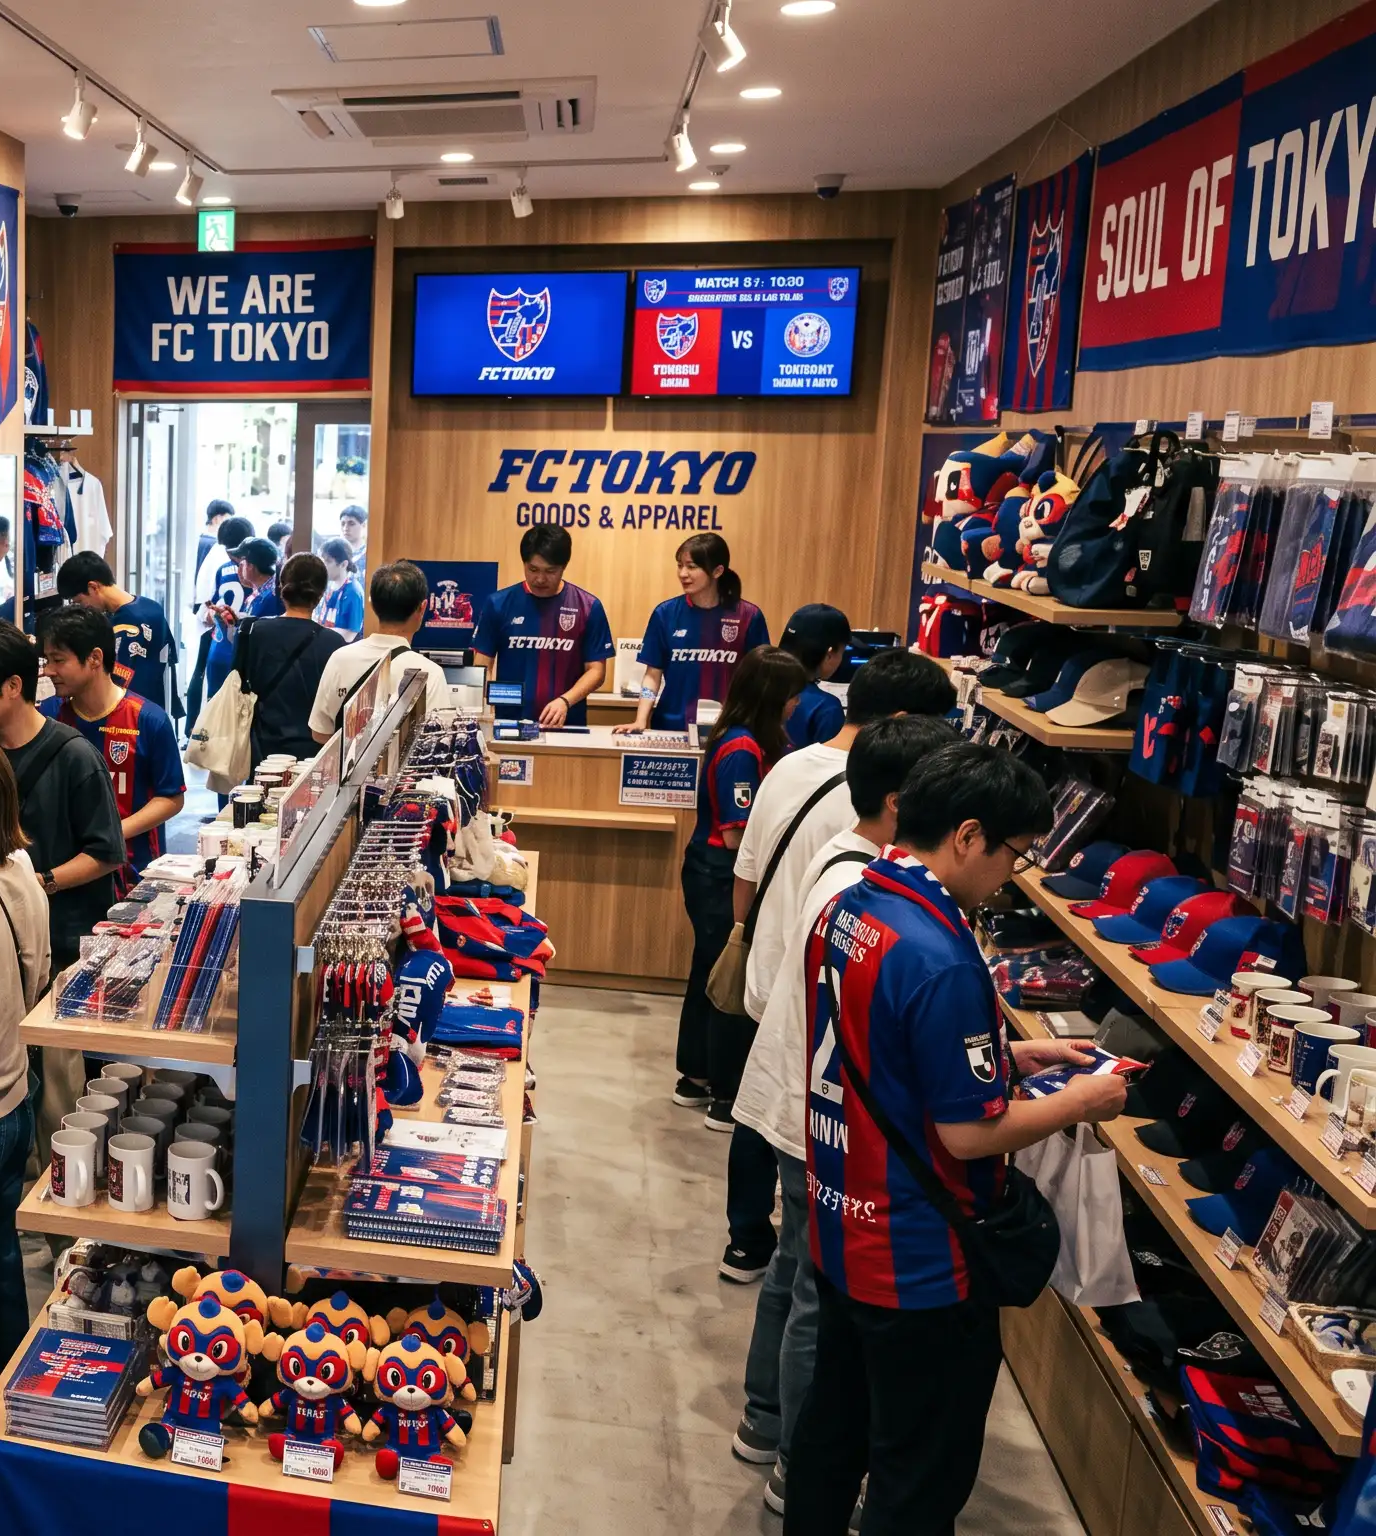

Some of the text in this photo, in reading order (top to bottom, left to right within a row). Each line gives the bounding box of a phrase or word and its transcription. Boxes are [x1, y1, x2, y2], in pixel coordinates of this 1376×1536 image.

[1096, 181, 1169, 303] SOUL
[1180, 153, 1234, 282] OF
[1245, 95, 1376, 269] TOKY
[166, 273, 316, 316] WE ARE
[694, 277, 739, 289] MATCH
[151, 320, 329, 362] FC TOKYO
[731, 330, 753, 349] VS
[516, 502, 723, 531] GOODS & APPAREL
